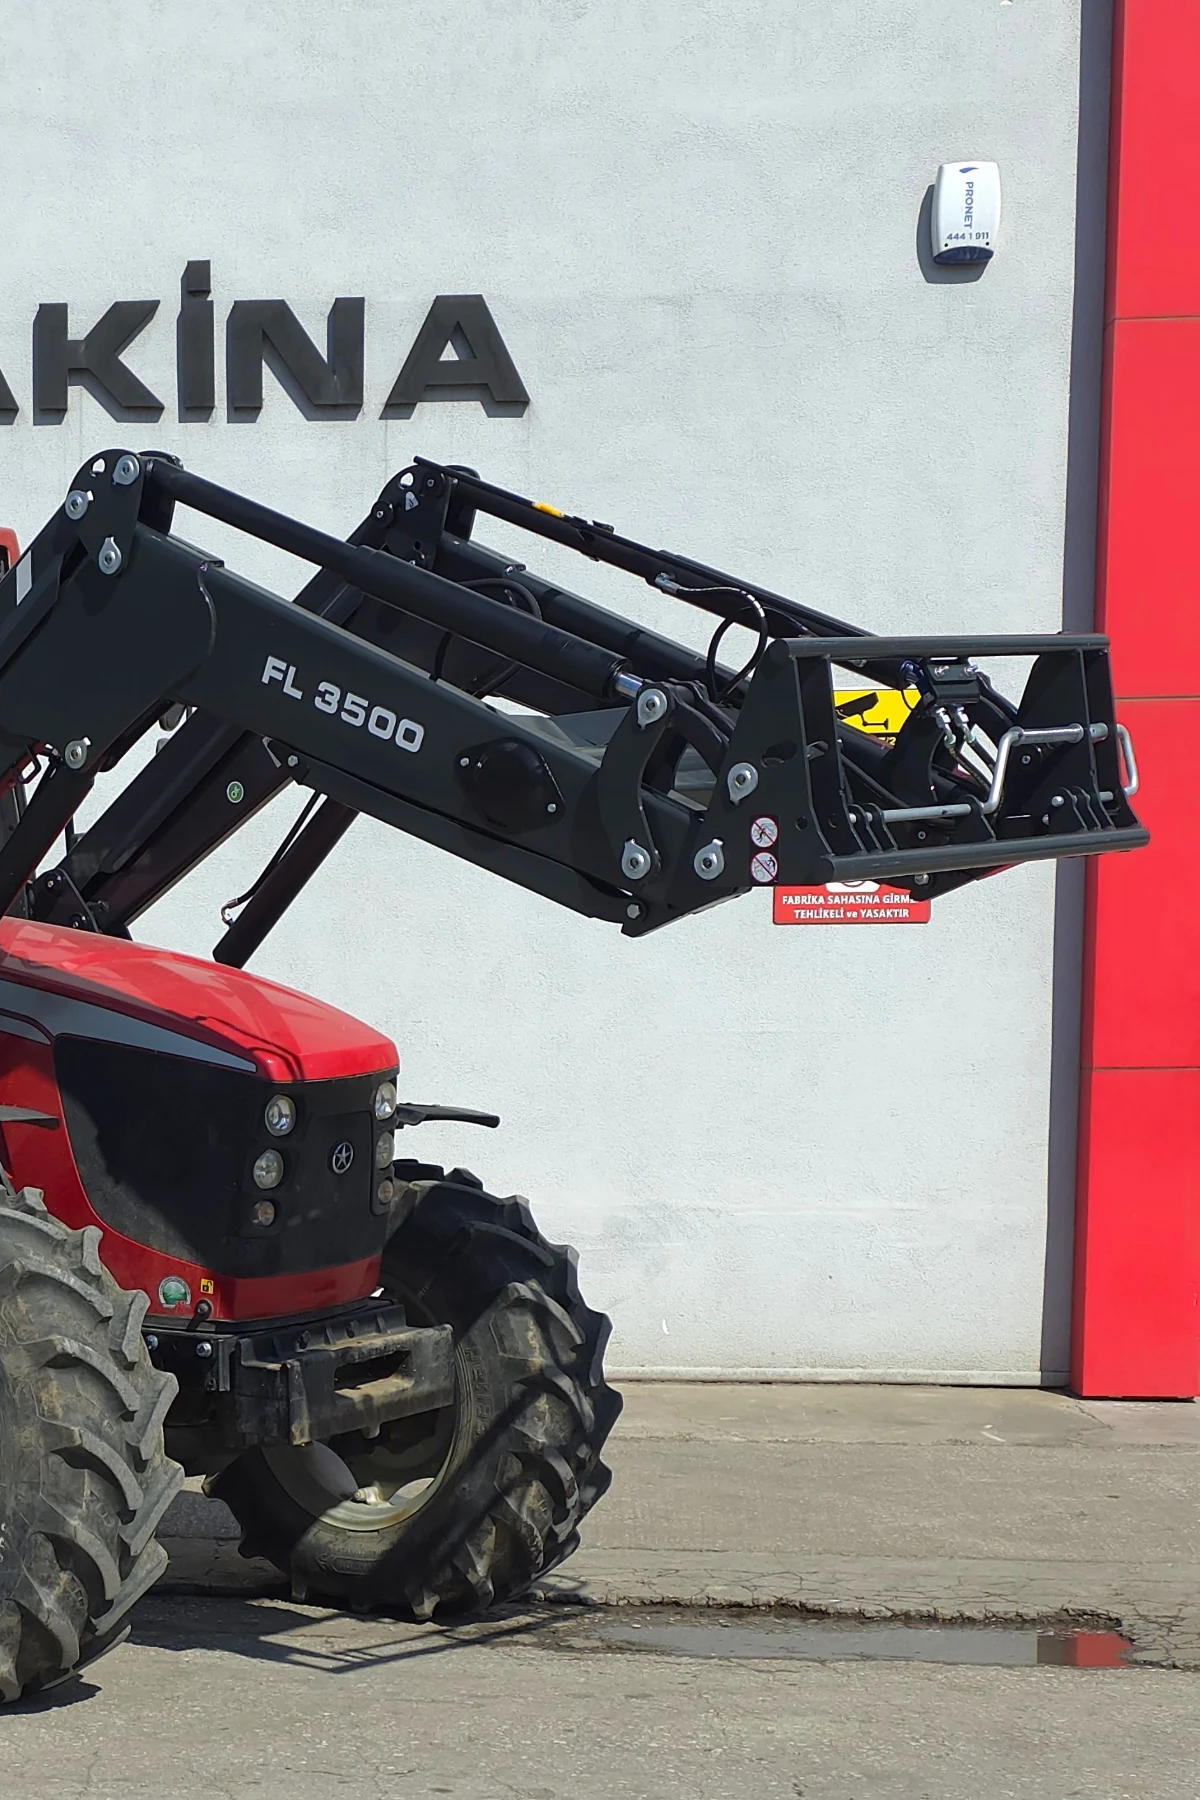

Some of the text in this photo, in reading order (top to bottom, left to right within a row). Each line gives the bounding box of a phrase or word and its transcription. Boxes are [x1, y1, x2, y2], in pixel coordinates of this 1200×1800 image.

[964, 181, 974, 229] PRONET
[947, 232, 966, 240] 444
[261, 655, 425, 753] FL 3500
[782, 892, 920, 905] FABRİKA SAHASINA GİRM
[793, 907, 910, 919] TEHLİKELİ ve YASAKTIR
